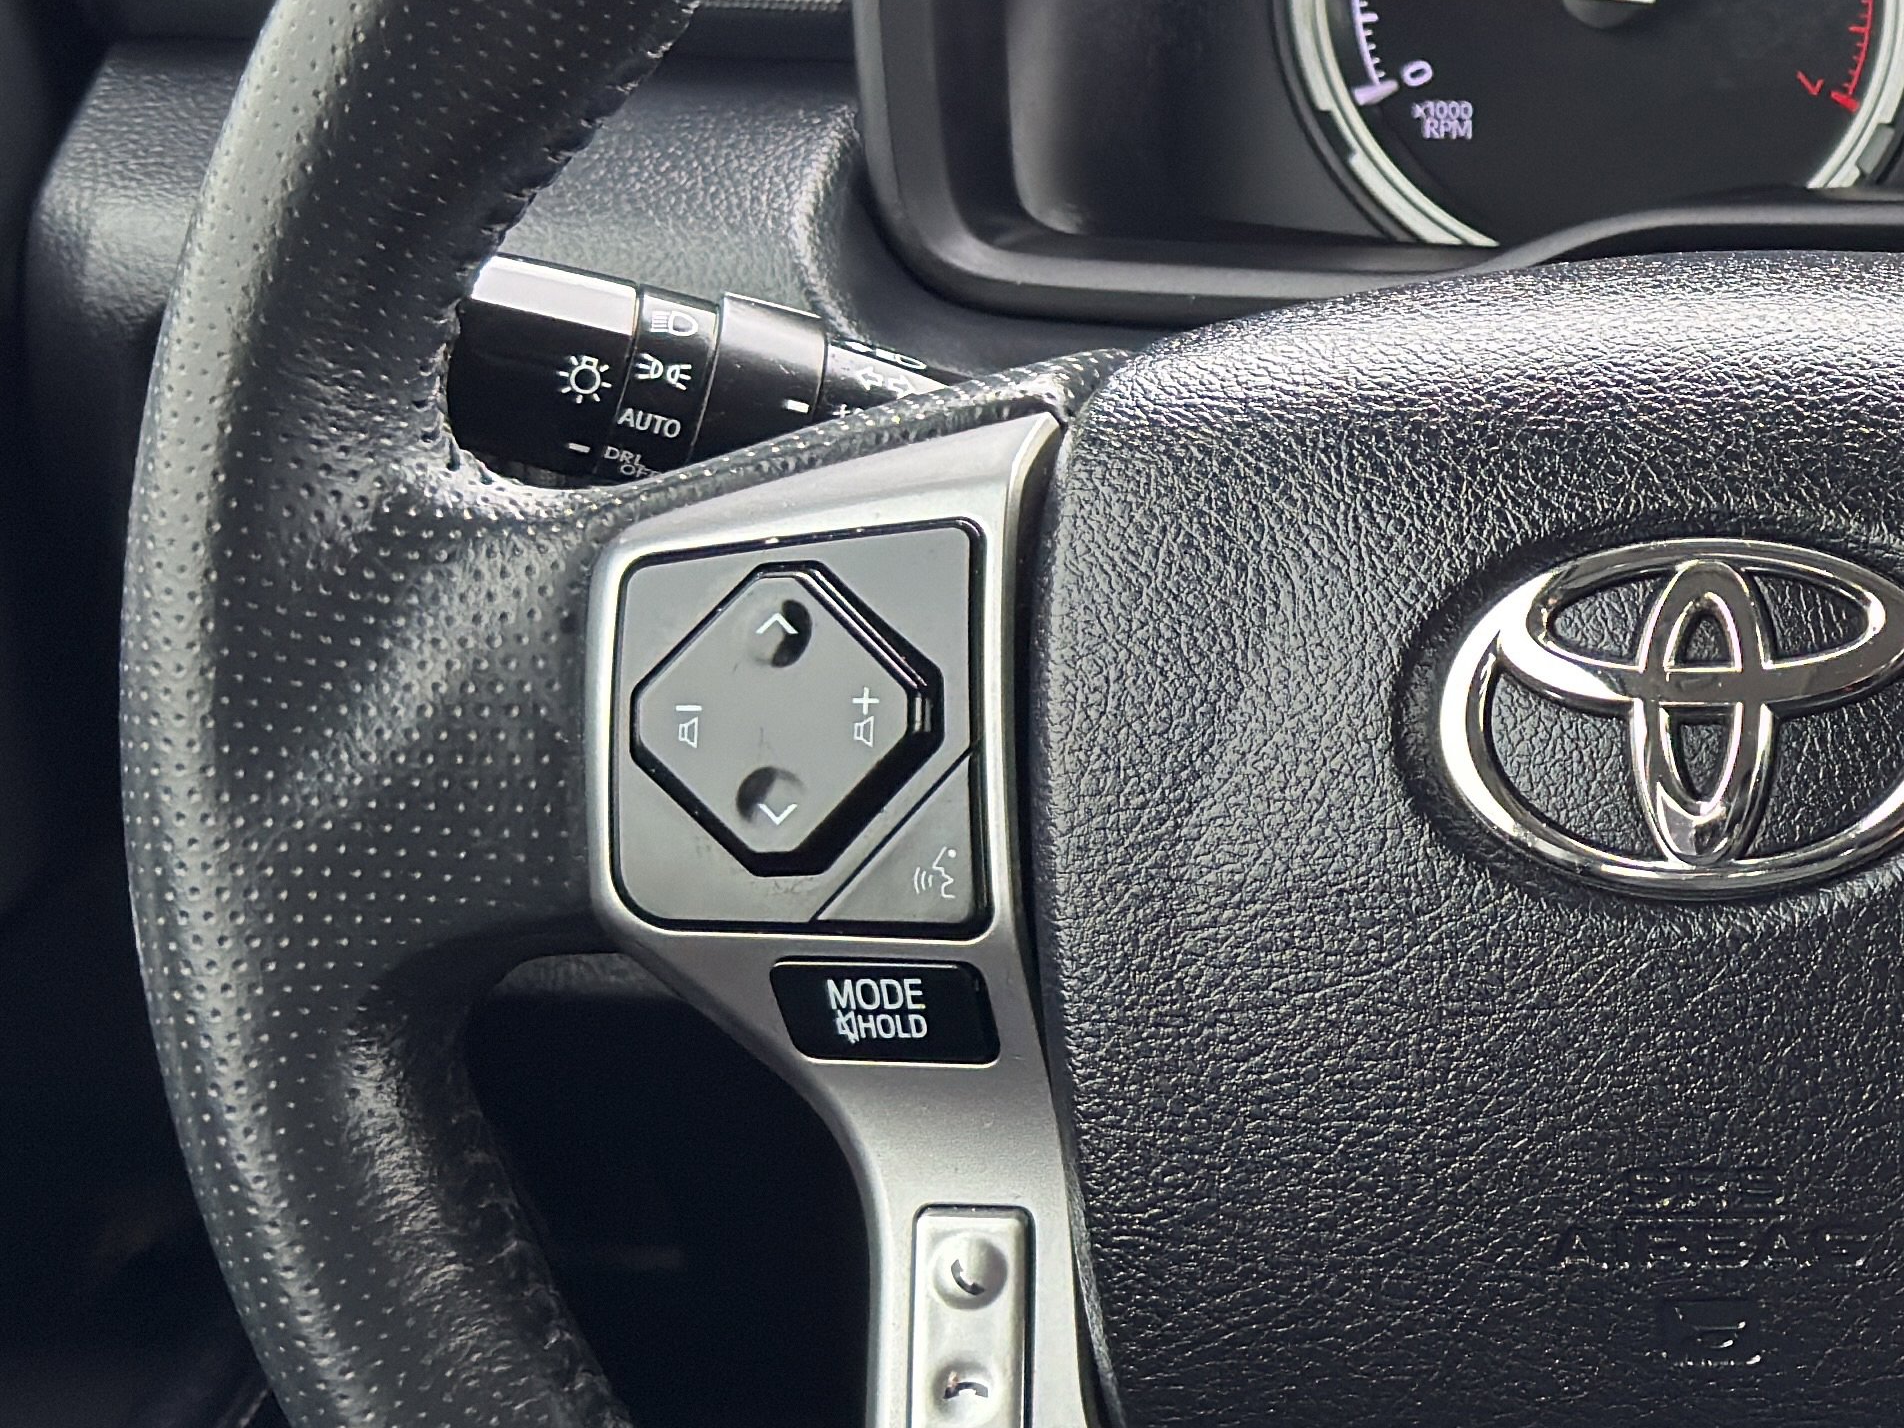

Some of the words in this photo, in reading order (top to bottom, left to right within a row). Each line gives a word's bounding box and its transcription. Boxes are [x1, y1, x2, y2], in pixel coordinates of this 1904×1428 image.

[1402, 59, 1435, 88] 0
[1422, 118, 1474, 140] RPM
[616, 406, 682, 439] AUTO
[603, 444, 648, 468] DRL
[826, 977, 924, 1010] MODE
[860, 1014, 929, 1040] HOLD
